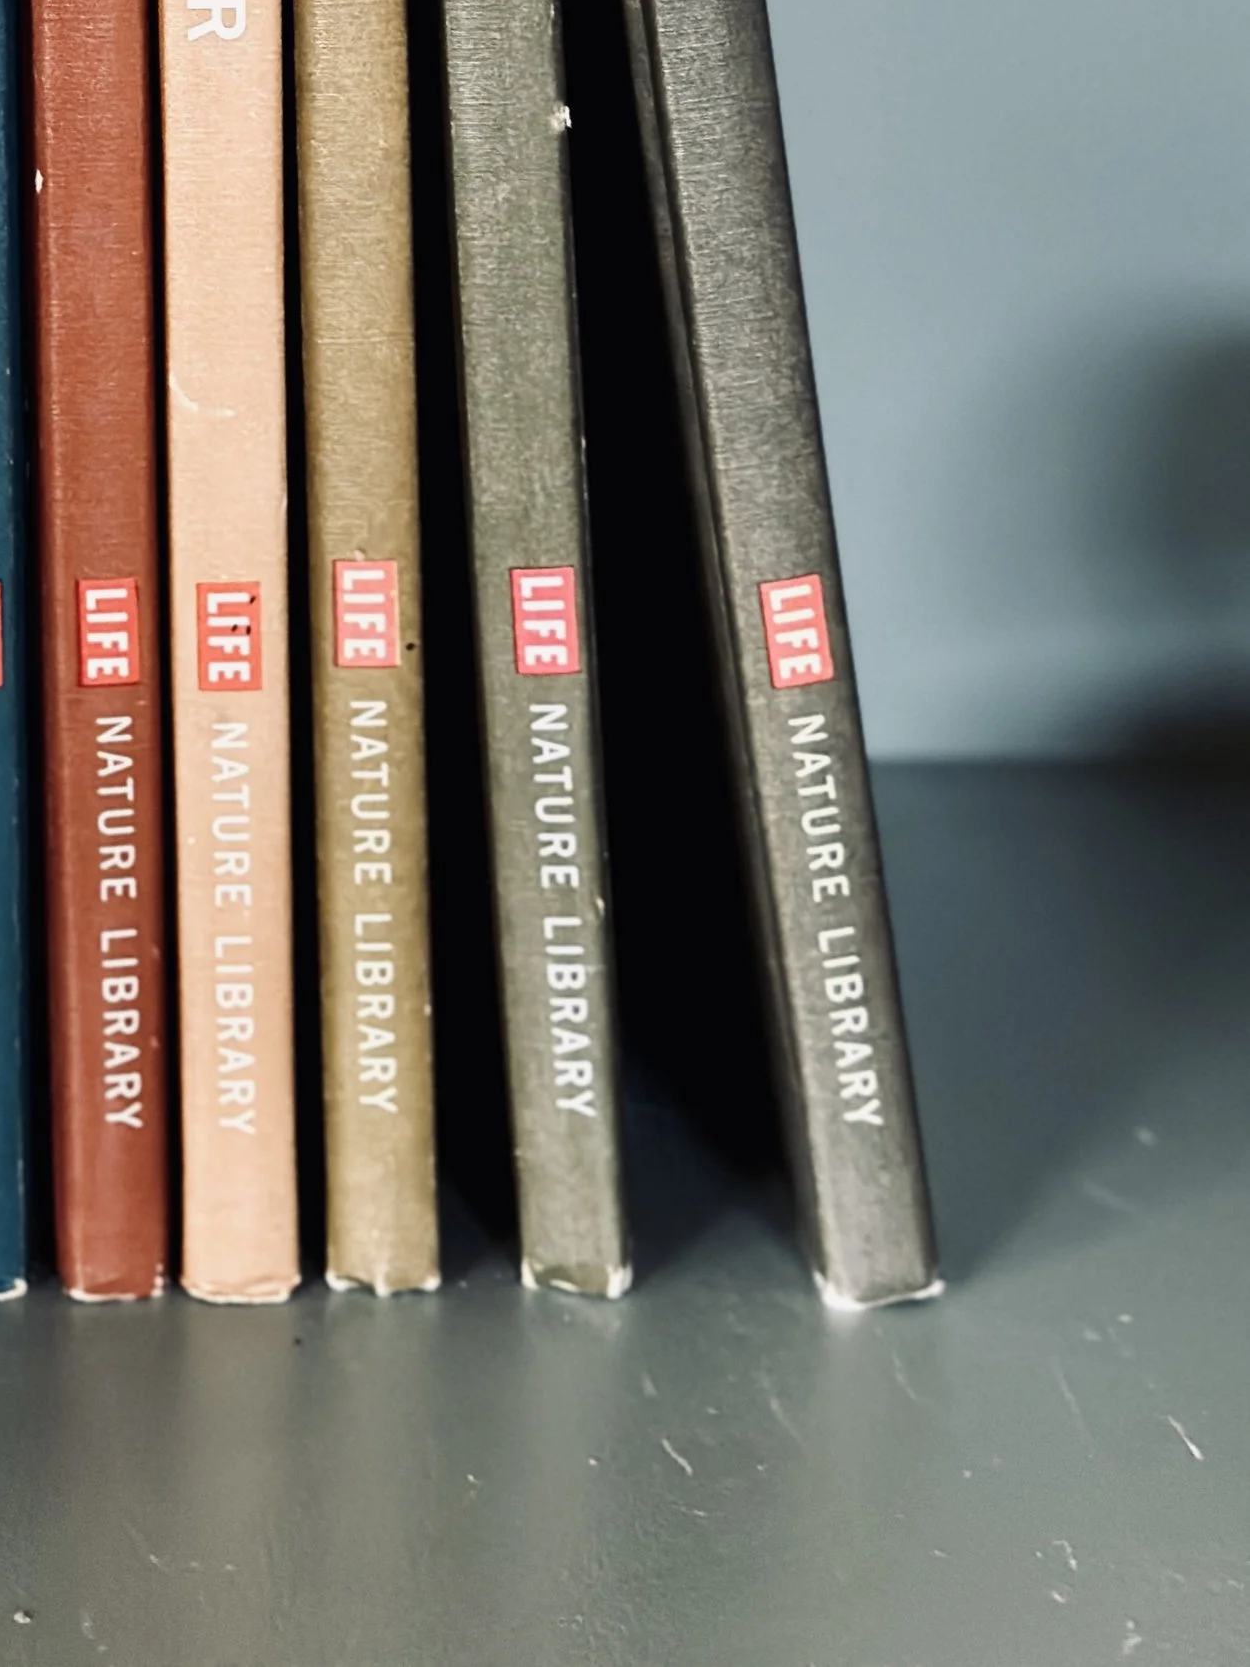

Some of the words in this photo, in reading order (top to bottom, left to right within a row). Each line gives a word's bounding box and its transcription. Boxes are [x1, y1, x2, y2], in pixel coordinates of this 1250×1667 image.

[83, 587, 131, 680] LIFE
[206, 591, 252, 683] LIFE
[341, 567, 389, 661] LIFE
[518, 574, 570, 668] LIFE
[769, 583, 825, 680] LIFE
[94, 716, 136, 900] NATURE
[210, 723, 252, 908] NATURE
[350, 699, 393, 885] NATURE
[529, 704, 580, 889] NATURE
[787, 714, 850, 902] NATURE
[100, 929, 143, 1130] LIBRARY
[215, 936, 256, 1136] LIBRARY
[354, 914, 398, 1114] LIBRARY
[543, 915, 597, 1119] LIBRARY
[818, 926, 884, 1128] LIBRARY
